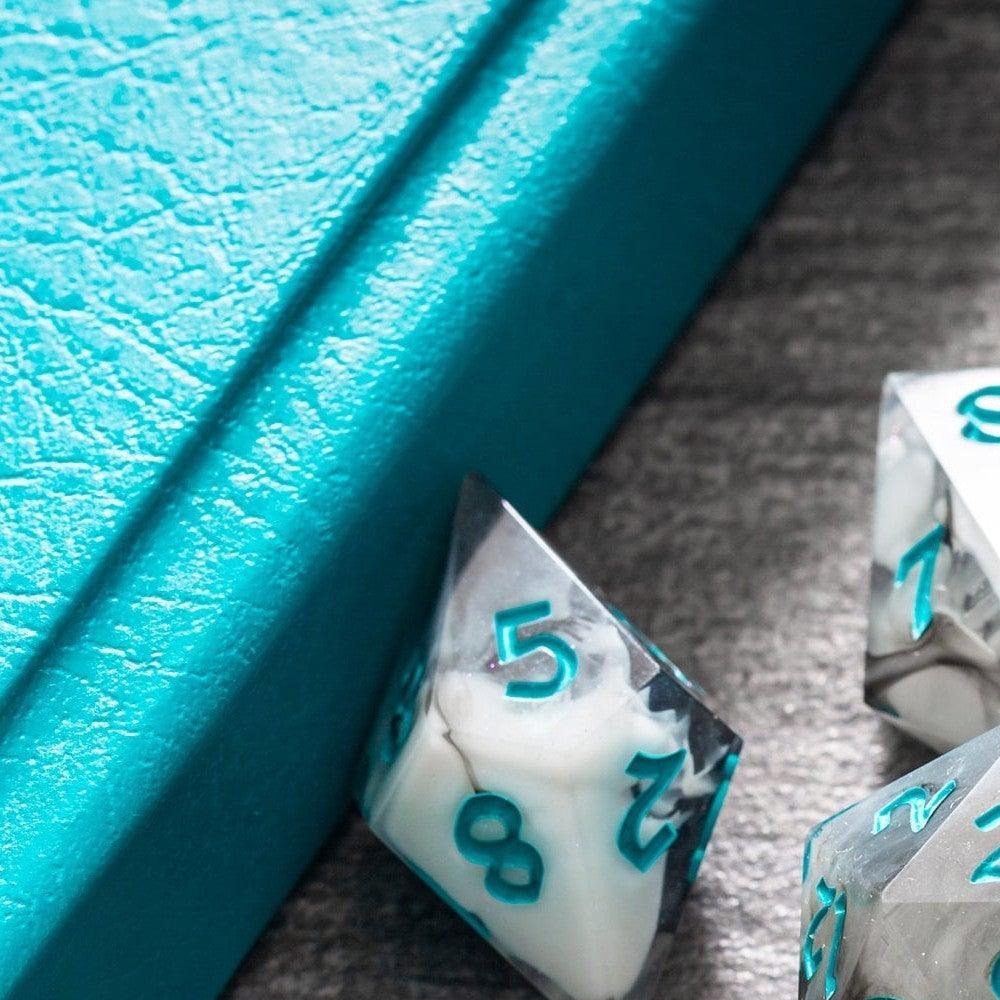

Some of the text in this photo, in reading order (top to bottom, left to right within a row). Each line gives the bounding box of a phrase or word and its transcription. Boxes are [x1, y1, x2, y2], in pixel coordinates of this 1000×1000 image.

[493, 599, 580, 699] 5
[452, 789, 545, 905] 8
[614, 747, 687, 874] 2
[872, 778, 958, 834] 2
